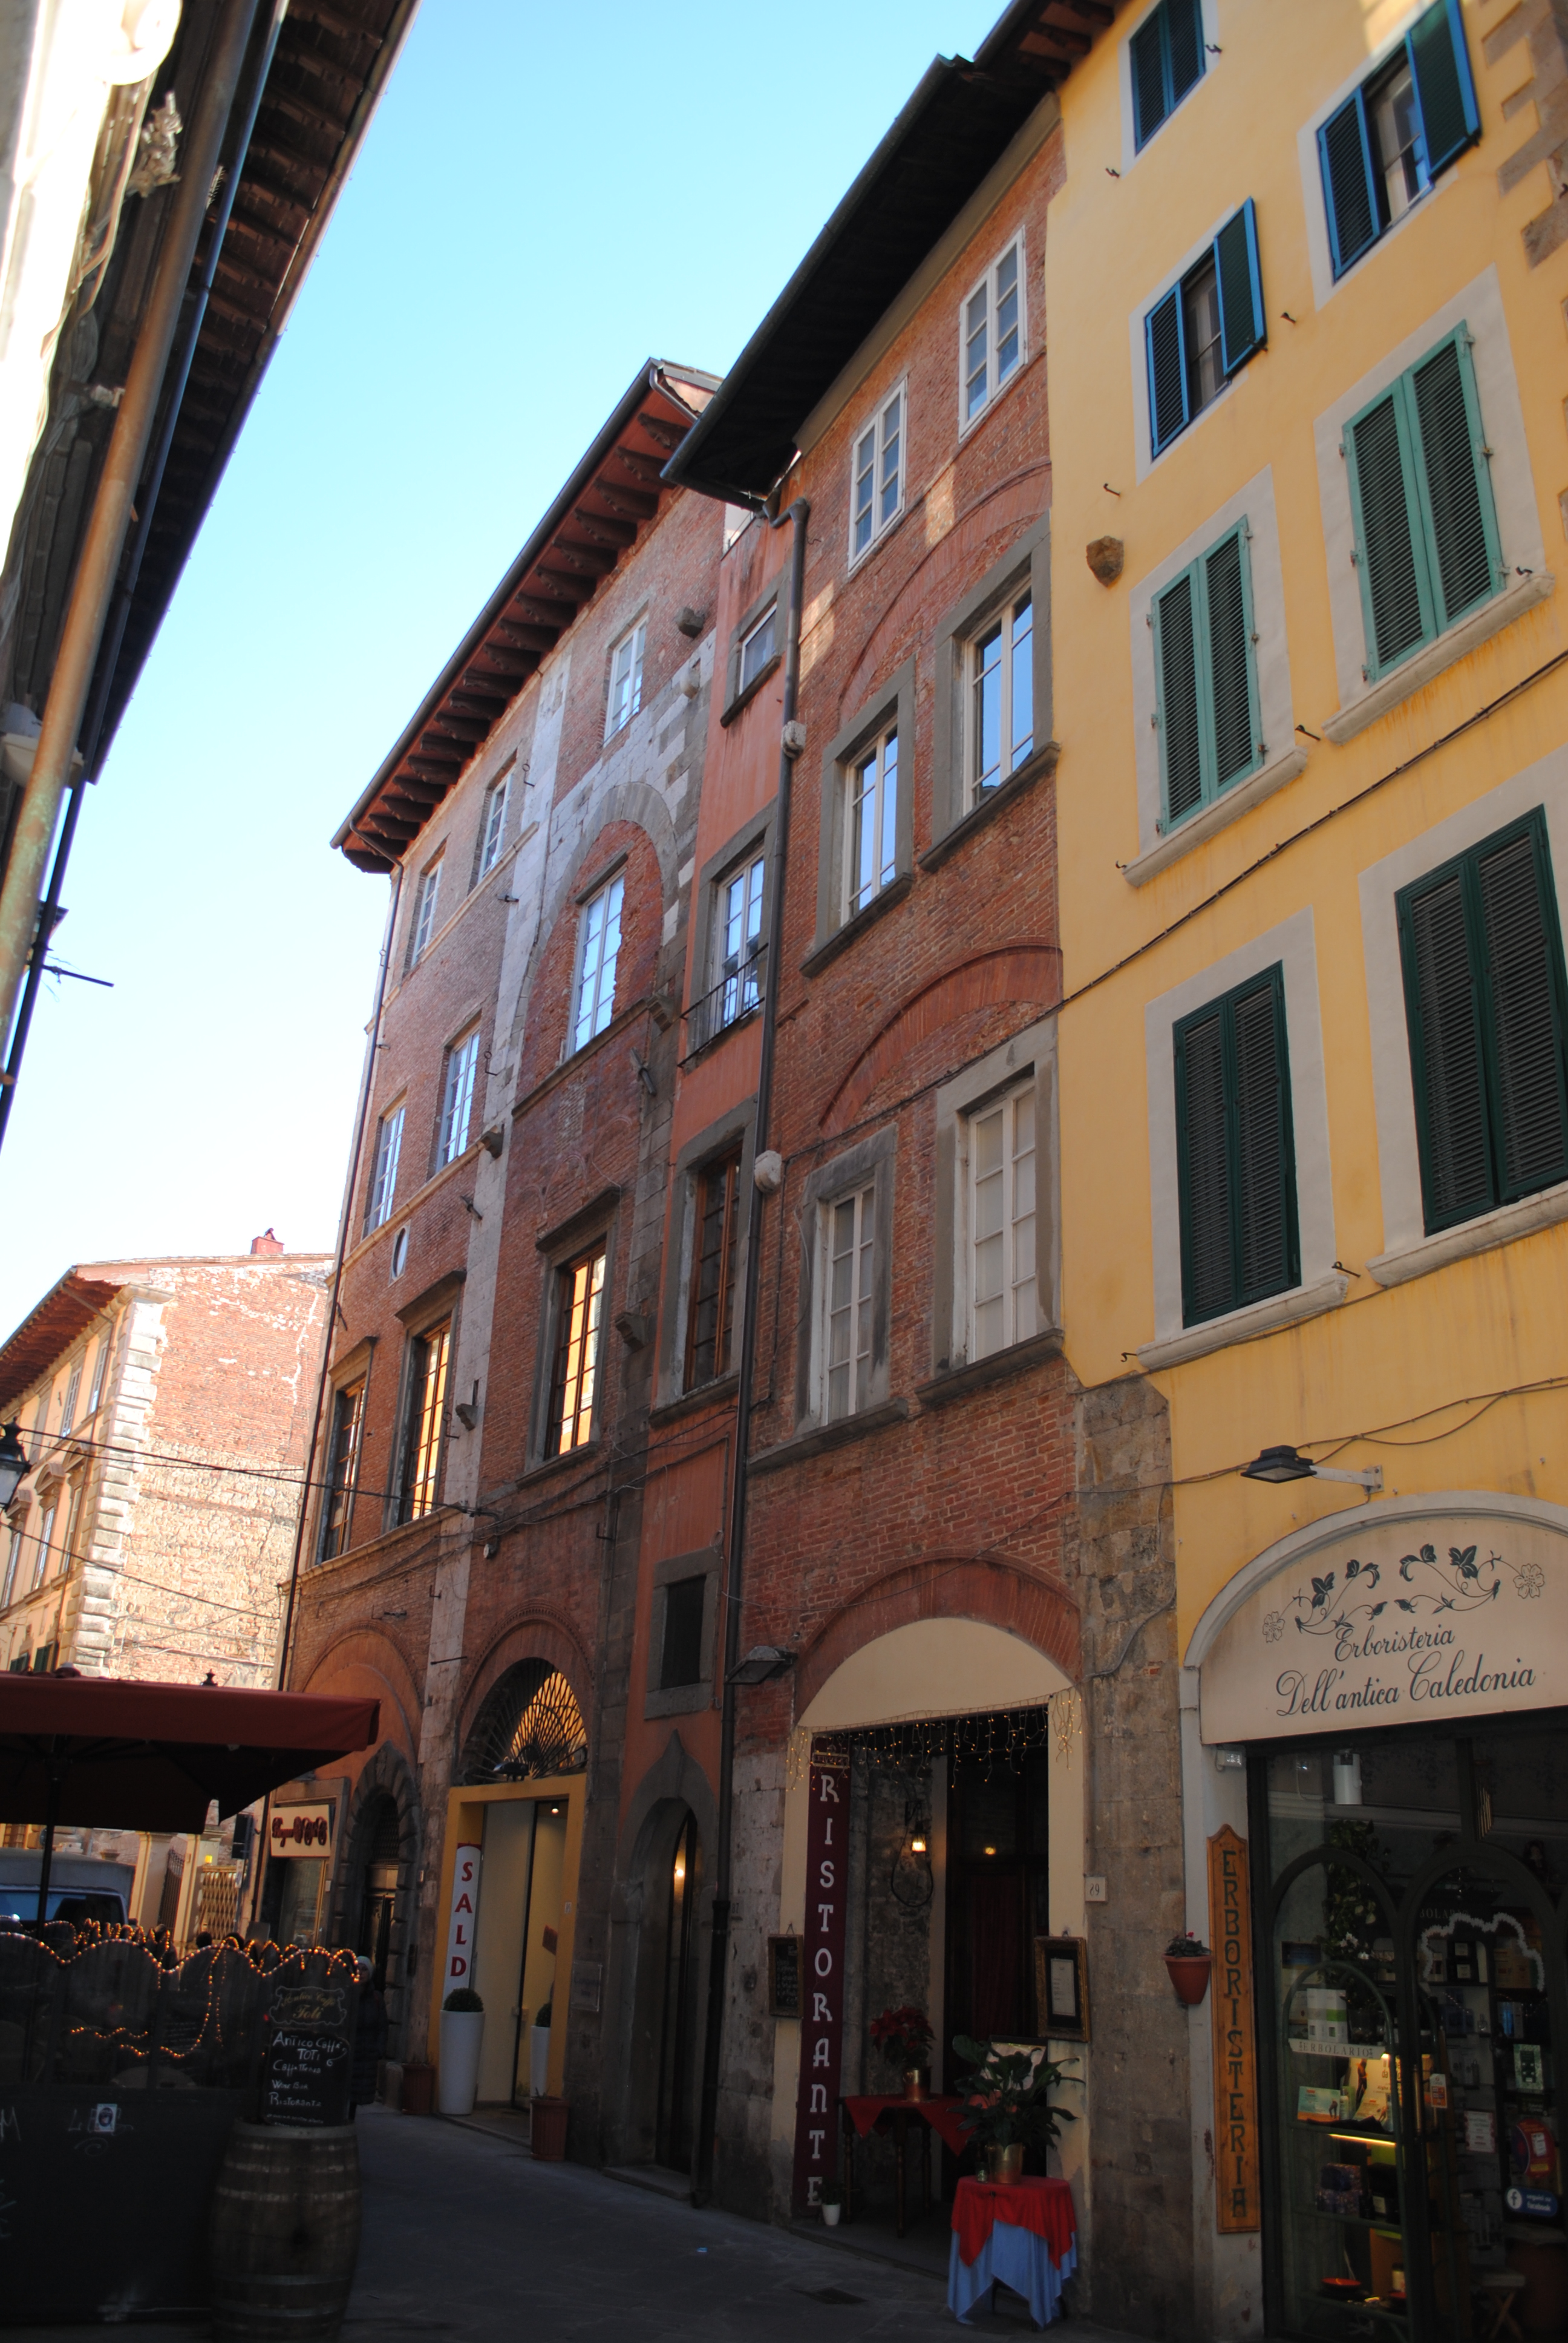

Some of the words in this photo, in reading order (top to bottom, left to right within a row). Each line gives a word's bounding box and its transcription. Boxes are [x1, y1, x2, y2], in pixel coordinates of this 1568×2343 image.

[1276, 1668, 1400, 1717] Dell'antica
[1407, 1649, 1537, 1702] Caledonia
[1334, 1624, 1455, 1662] Erboristeria
[807, 1774, 840, 2206] RISTORANTE
[1222, 1850, 1248, 2218] ERBORISTERIA
